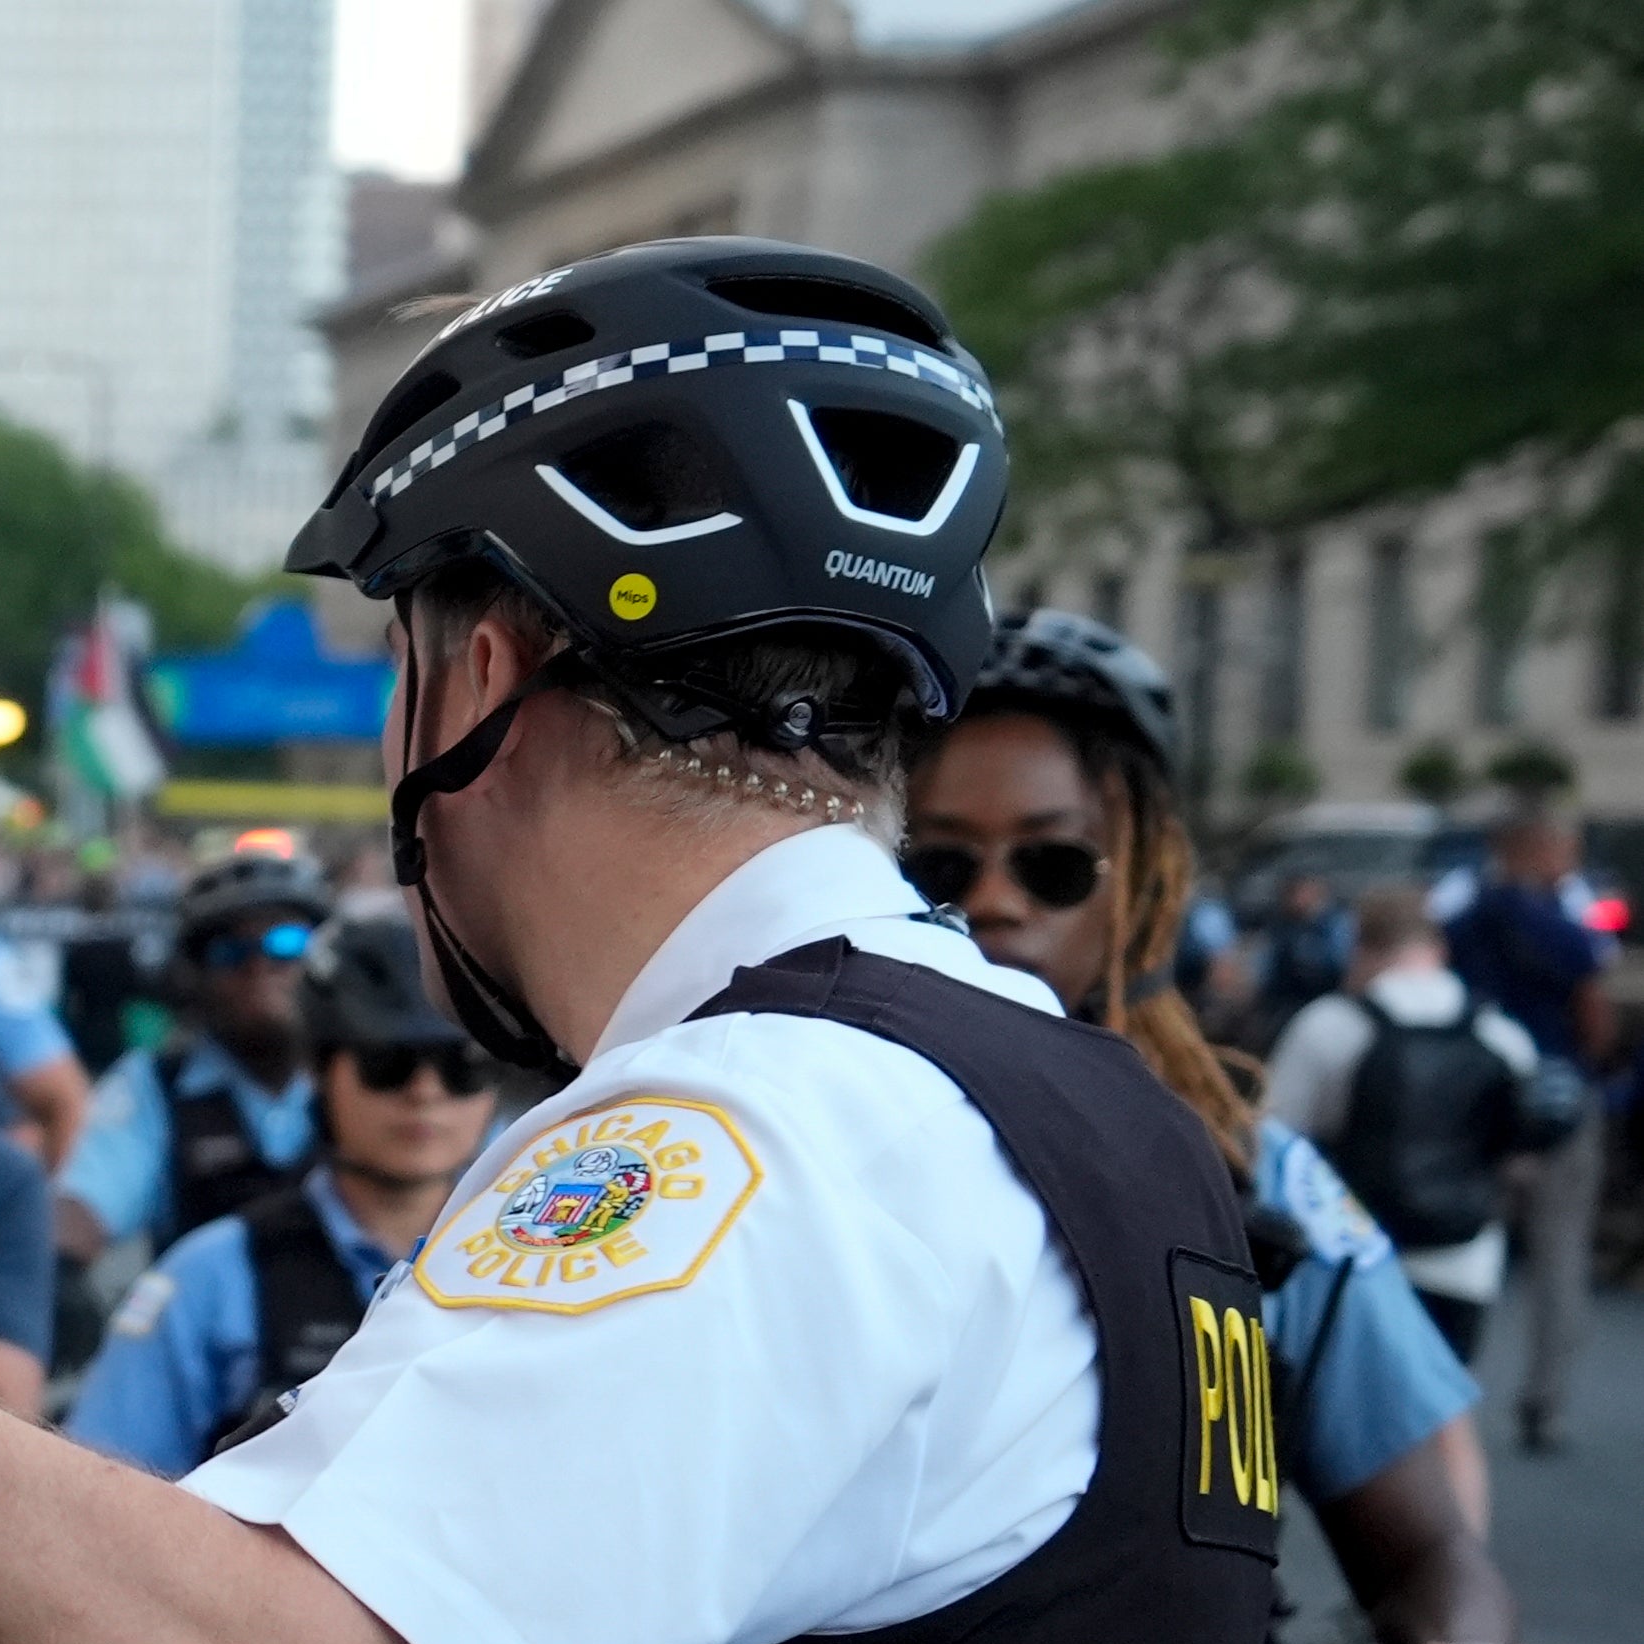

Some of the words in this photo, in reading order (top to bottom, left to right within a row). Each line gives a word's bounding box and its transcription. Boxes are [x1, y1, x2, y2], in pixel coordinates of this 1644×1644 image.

[615, 589, 650, 605] Mips
[824, 550, 935, 599] QUANTUM
[494, 1114, 706, 1199] CHICAGO
[455, 1227, 648, 1288] POLICE
